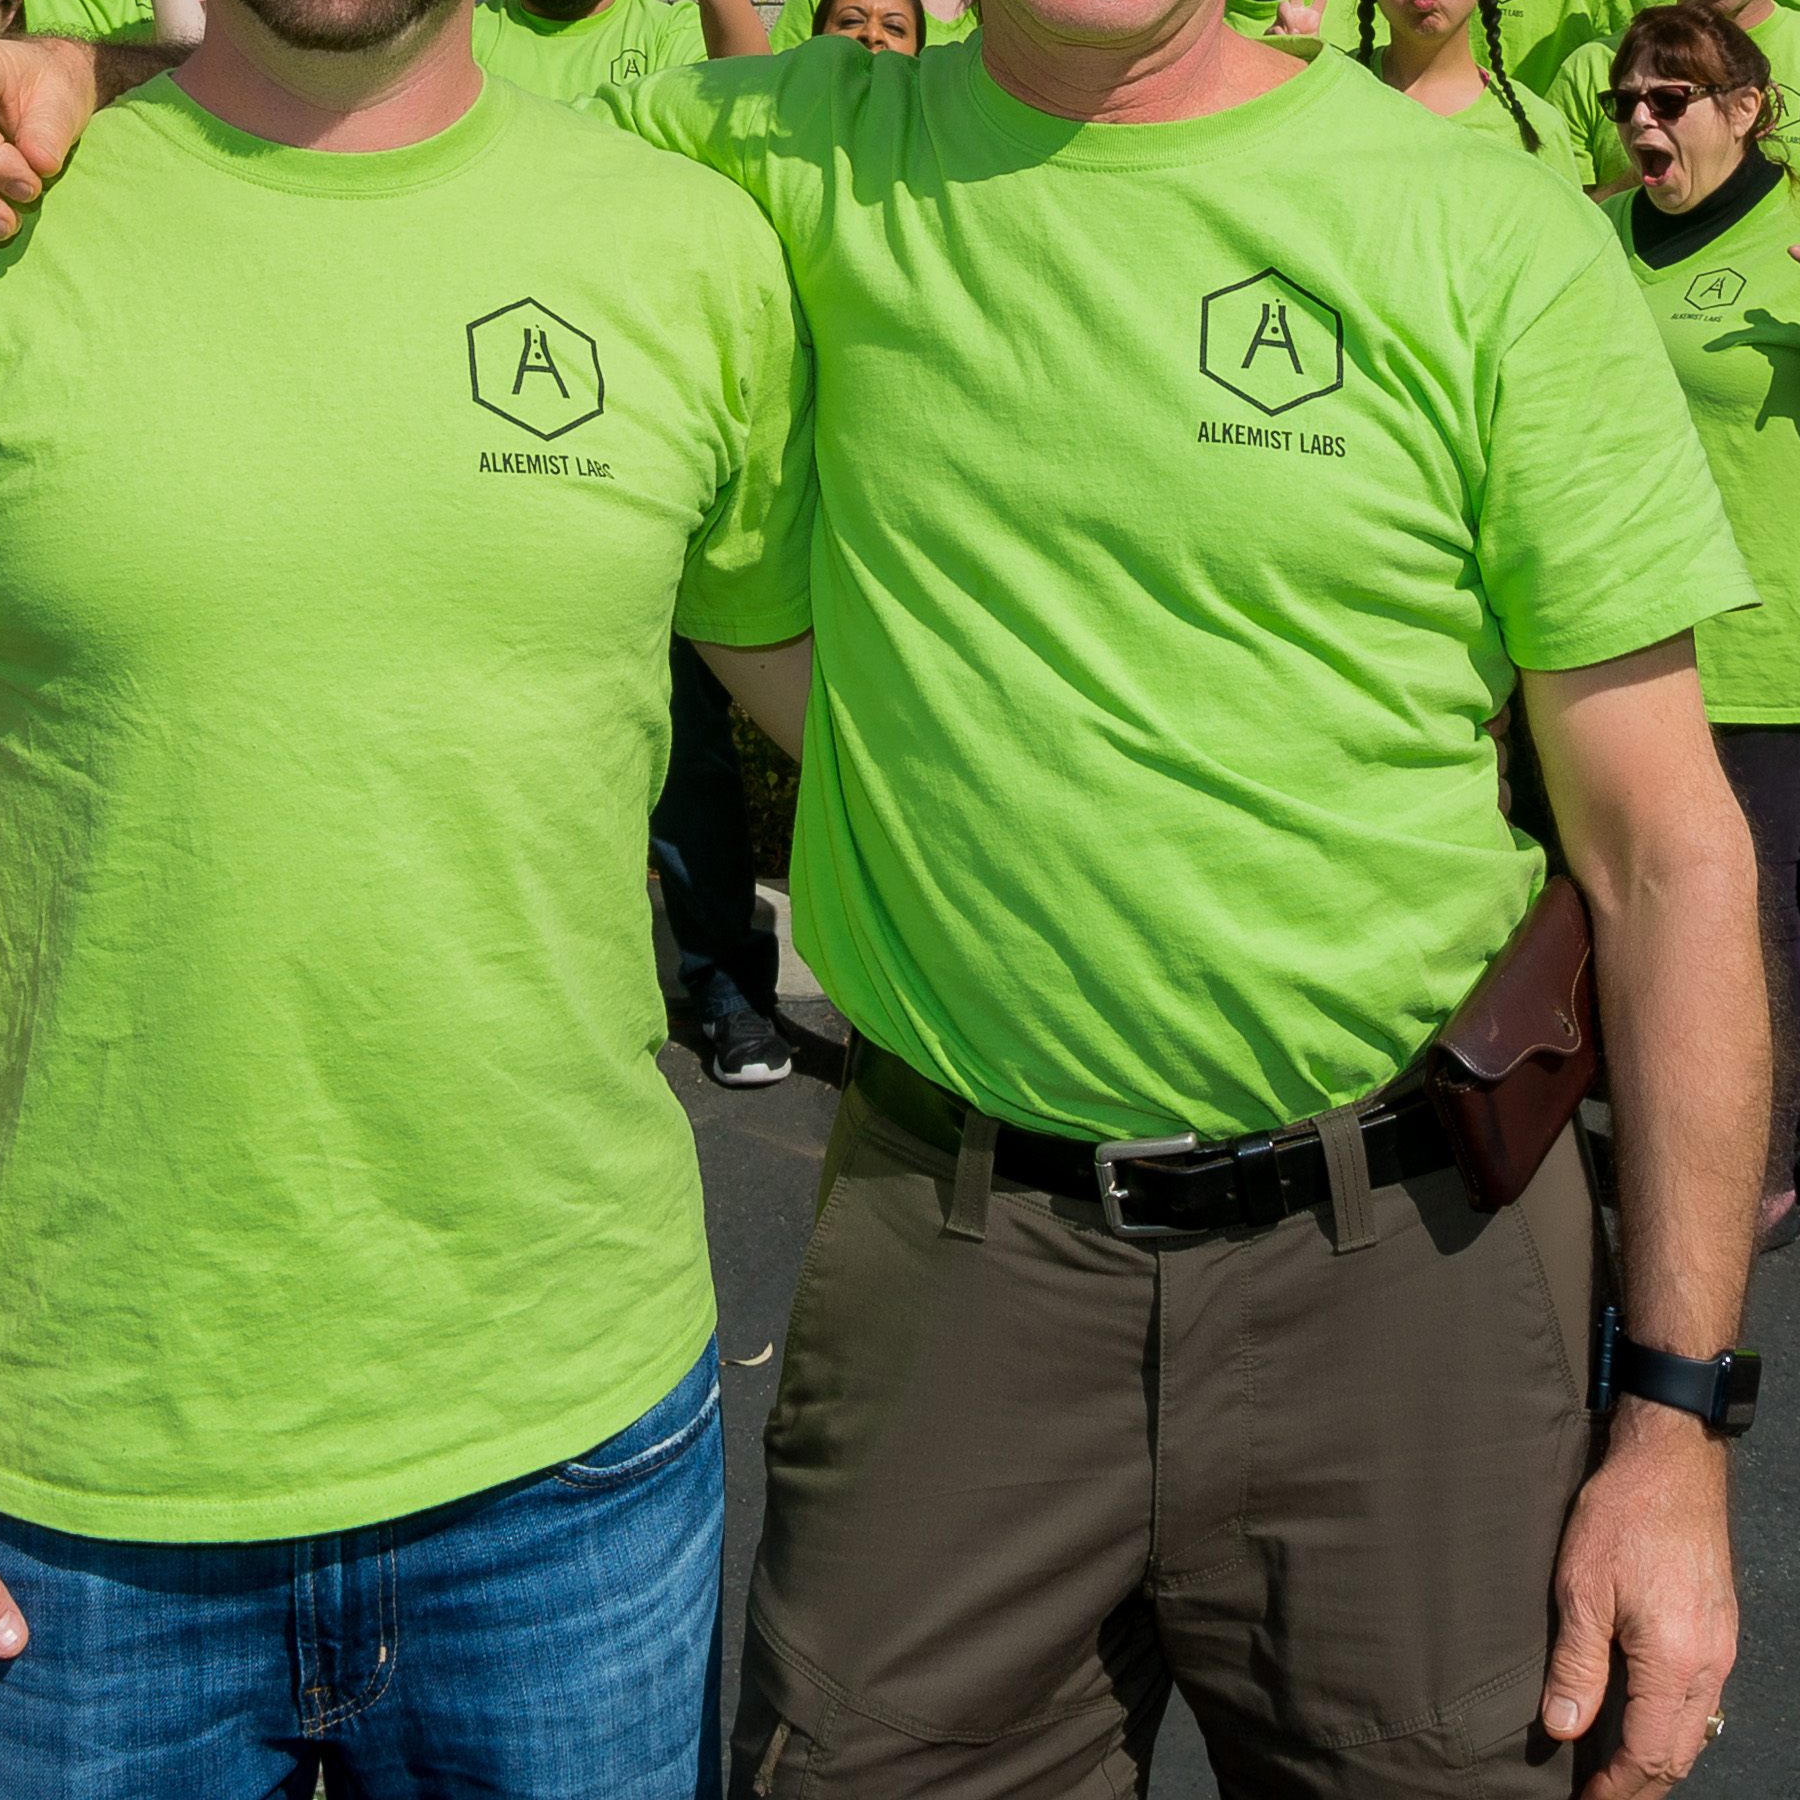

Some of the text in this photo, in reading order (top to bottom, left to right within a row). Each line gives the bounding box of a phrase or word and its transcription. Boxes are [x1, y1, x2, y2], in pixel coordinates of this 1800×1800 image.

[1507, 8, 1525, 18] LABS
[1670, 312, 1724, 323] ALKEMIST LABS
[1197, 421, 1347, 458] ALKEMIST LABS
[479, 451, 616, 480] ALKEMIST LABS
